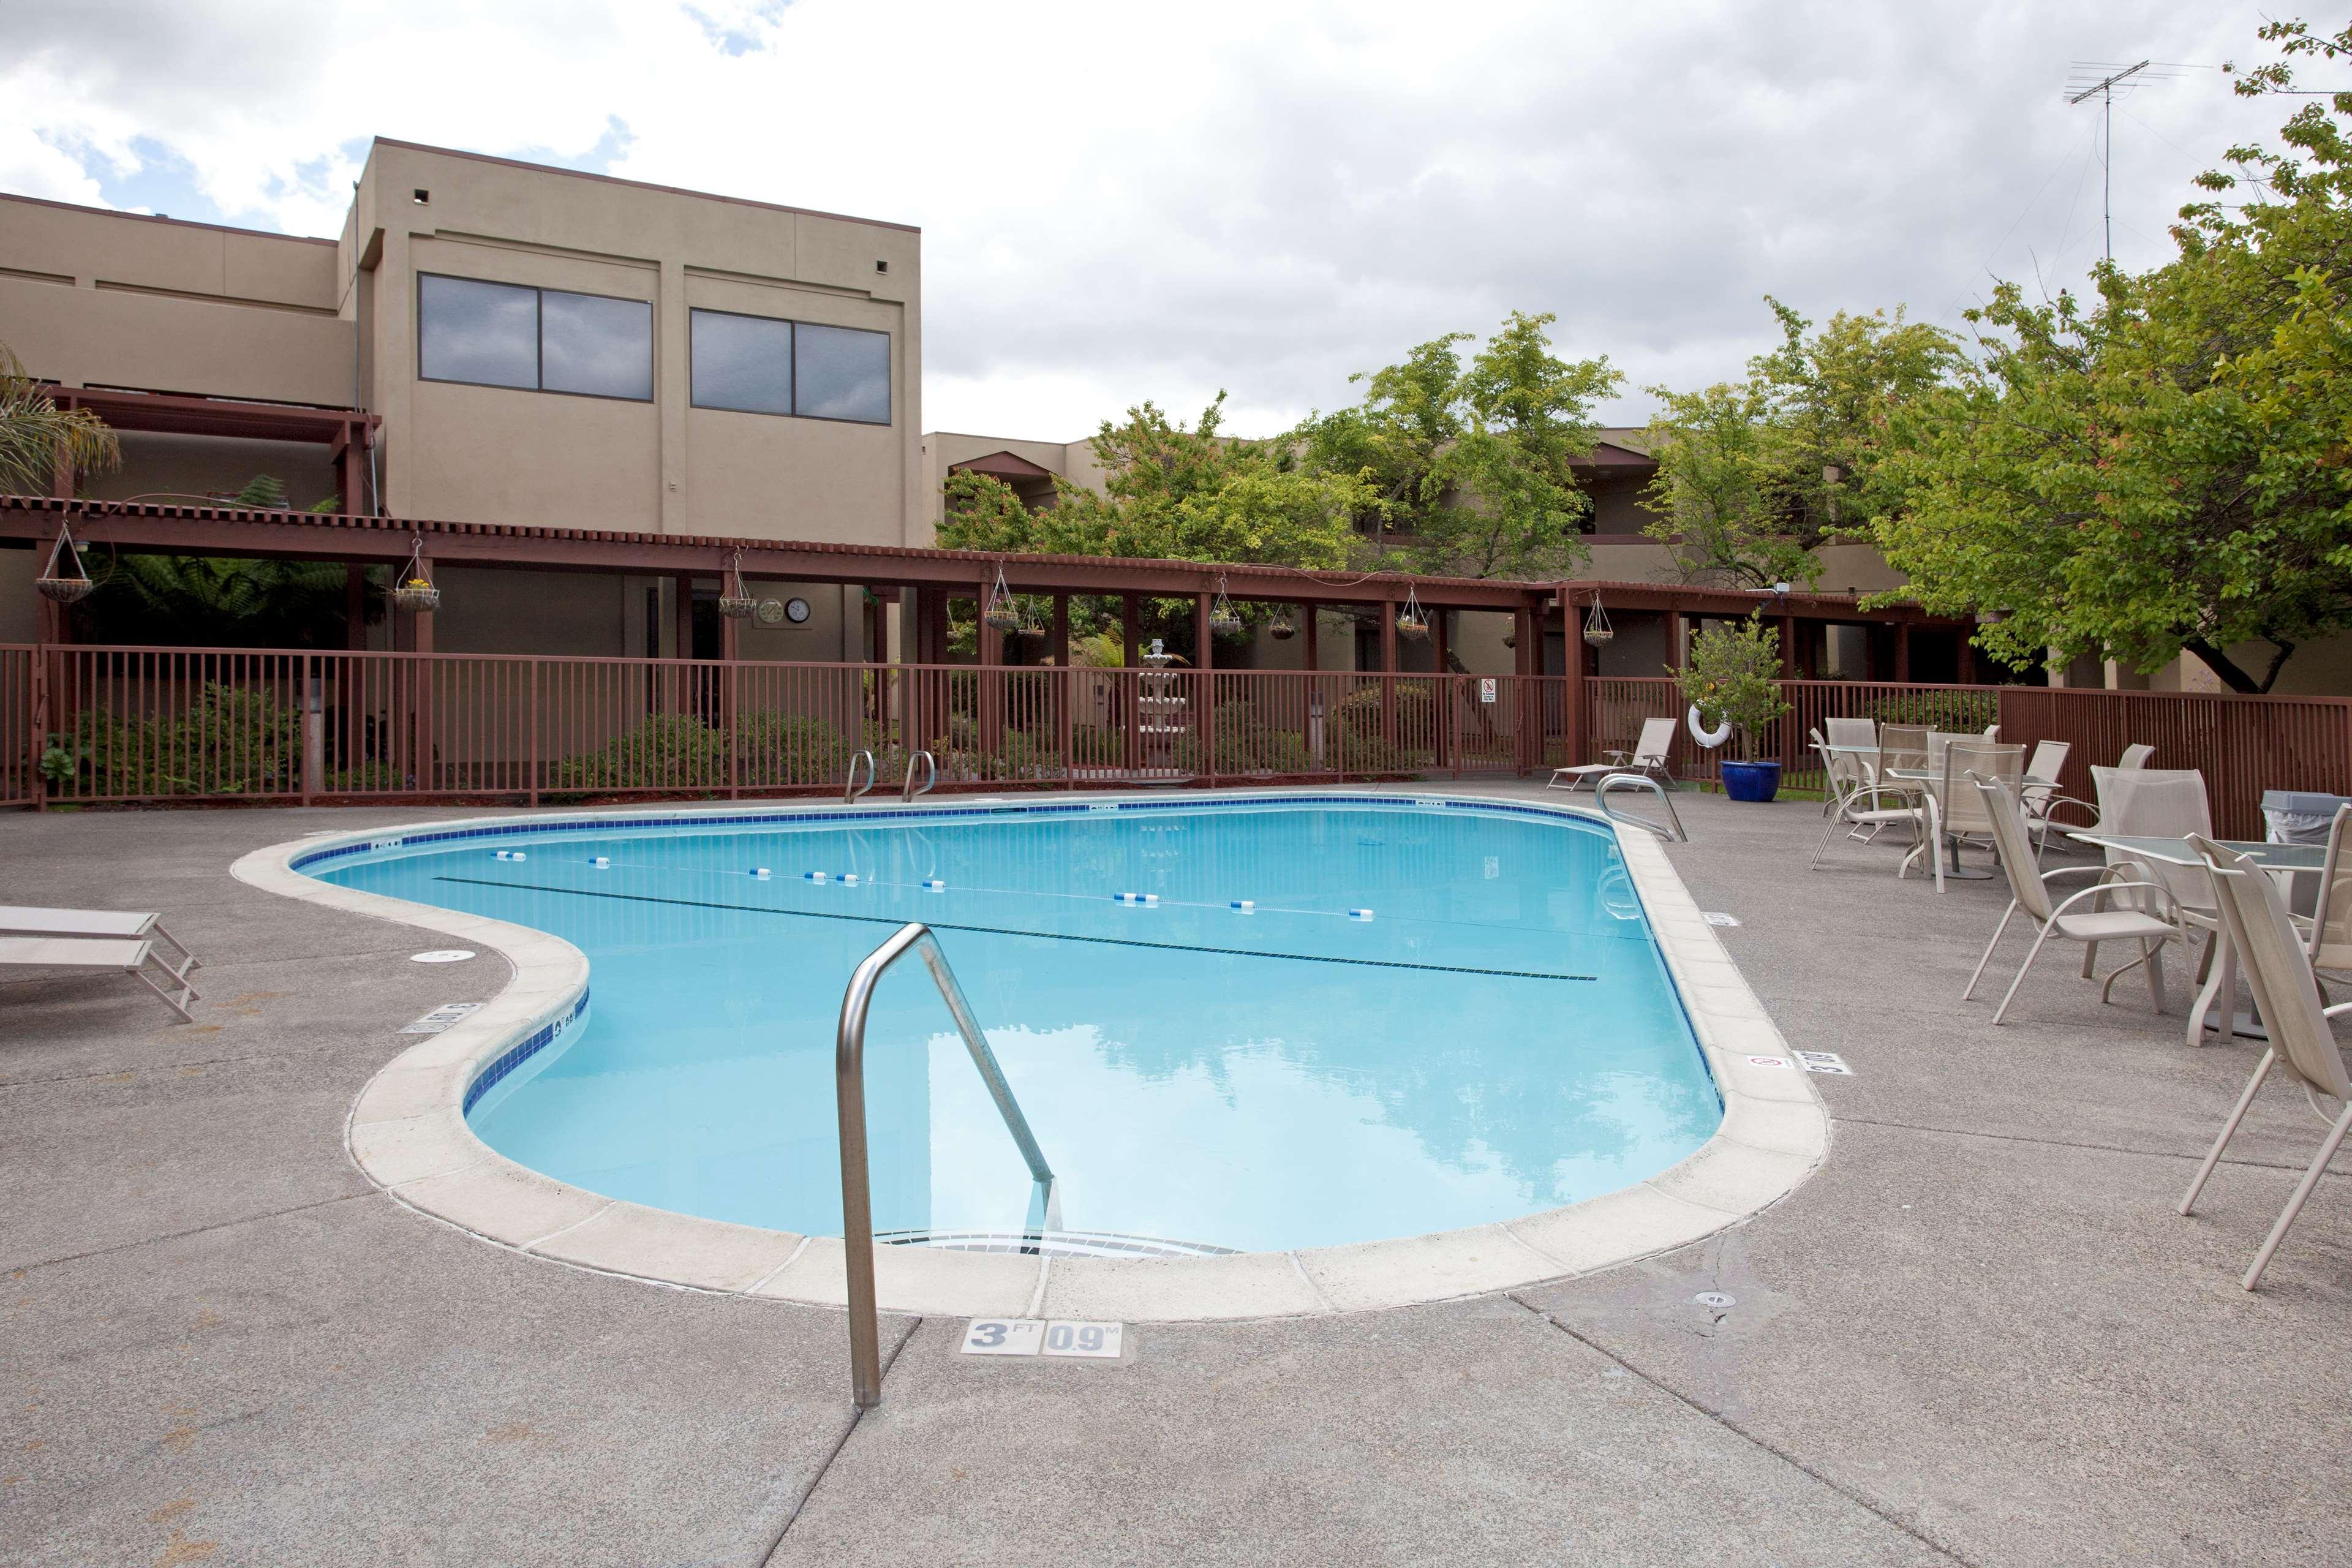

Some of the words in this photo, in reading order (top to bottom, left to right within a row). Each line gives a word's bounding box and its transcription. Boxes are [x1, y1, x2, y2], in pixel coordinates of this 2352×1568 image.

[971, 1323, 1008, 1348] 3
[1012, 1323, 1038, 1333] FT
[1047, 1325, 1104, 1351] 0.9
